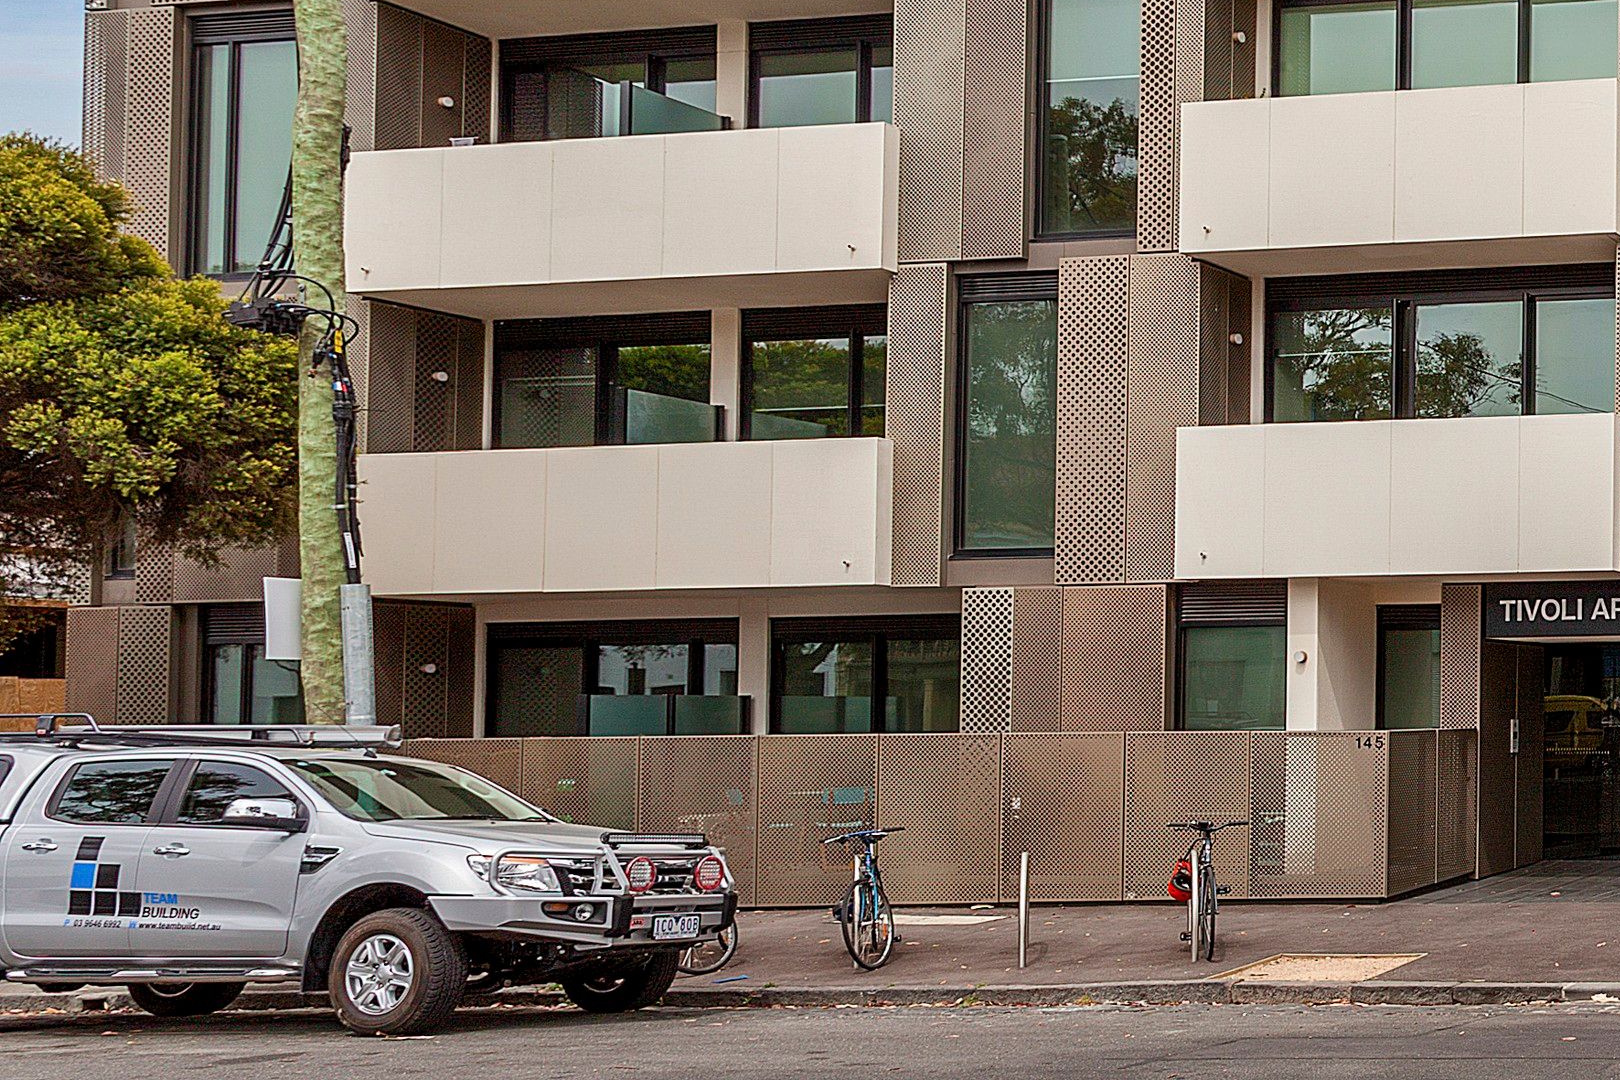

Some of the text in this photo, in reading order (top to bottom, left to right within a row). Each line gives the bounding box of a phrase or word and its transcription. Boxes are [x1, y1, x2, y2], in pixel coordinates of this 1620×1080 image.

[1500, 599, 1583, 622] TIVOLI
[1356, 736, 1384, 749] 145
[143, 892, 178, 904] TEAM
[142, 907, 200, 919] BUILDING
[73, 919, 83, 927] 03
[103, 920, 121, 928] 6992
[138, 922, 221, 931] www.teambuild.net.au
